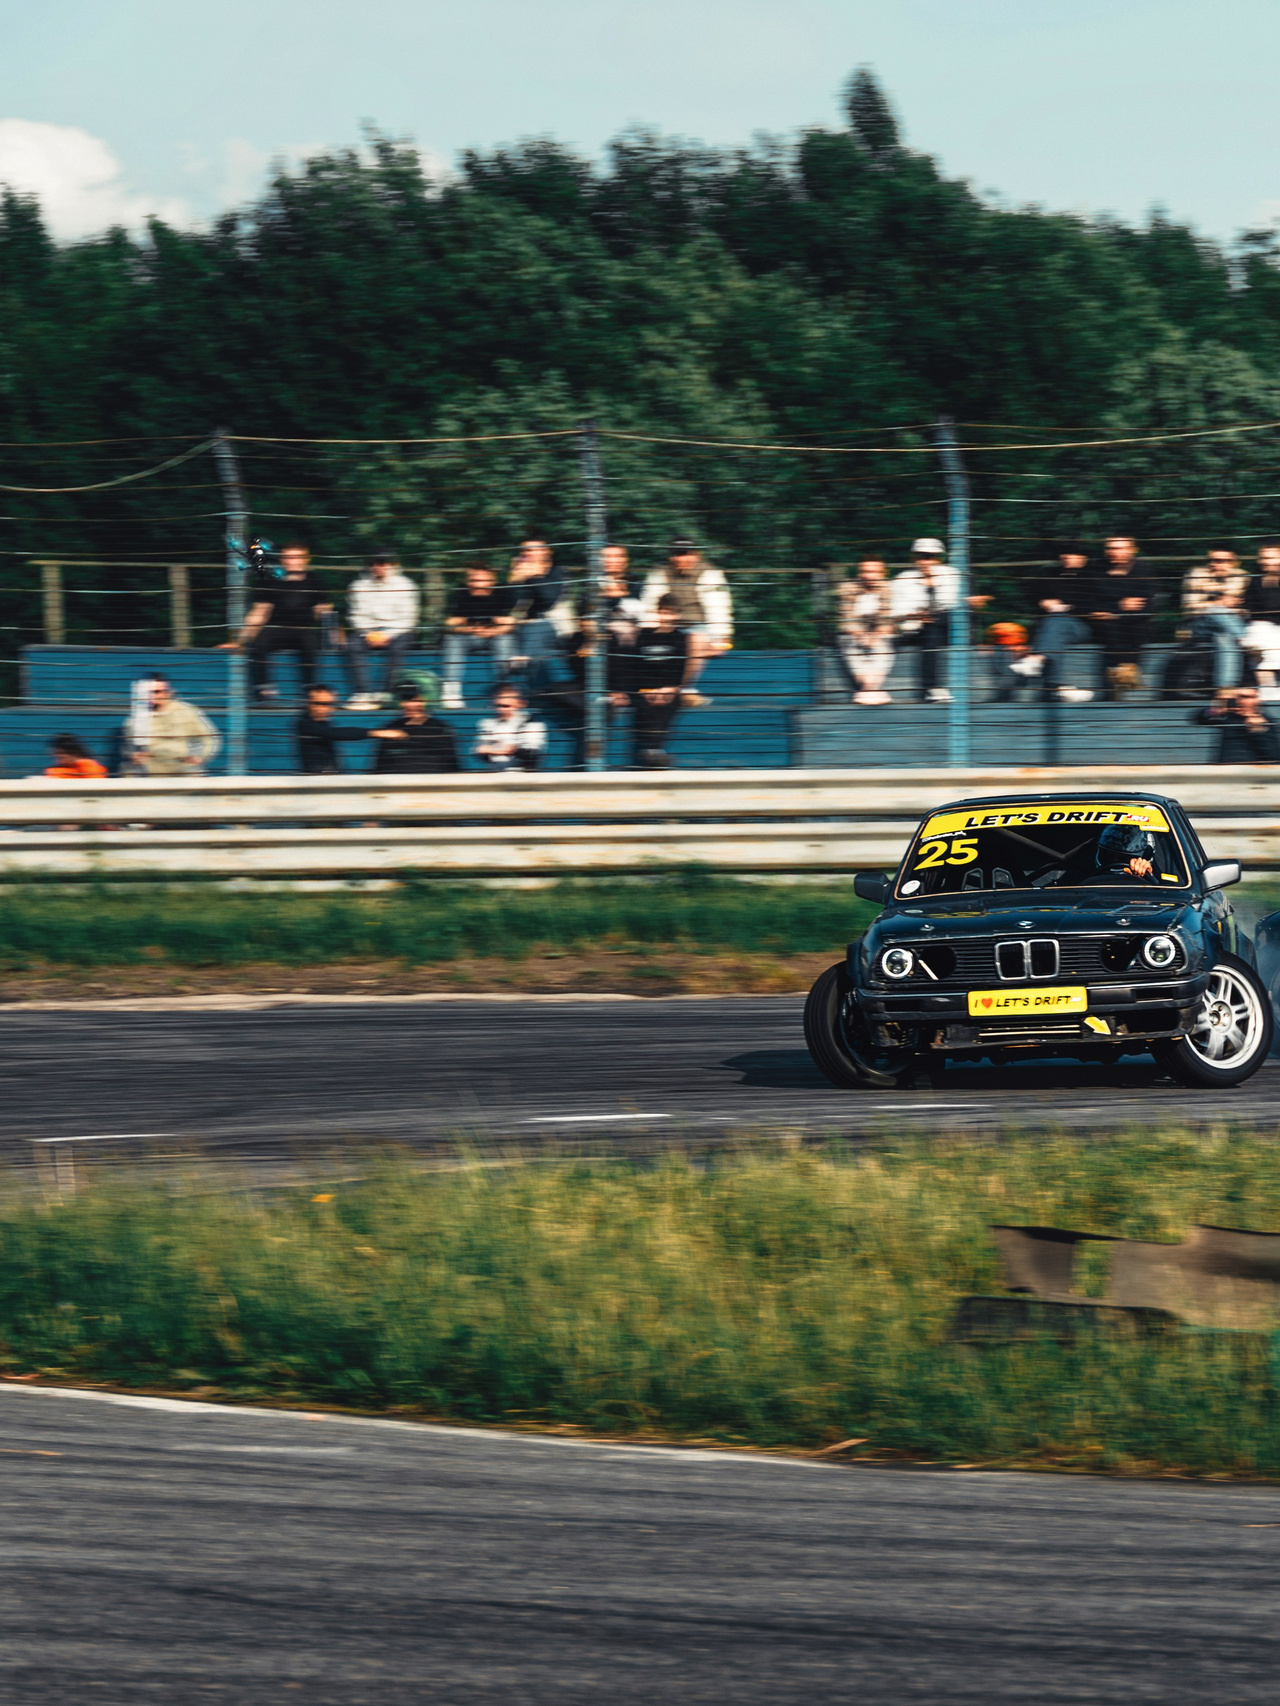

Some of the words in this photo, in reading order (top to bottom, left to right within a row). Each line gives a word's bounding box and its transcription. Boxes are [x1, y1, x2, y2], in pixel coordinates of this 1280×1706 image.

[964, 812, 1040, 828] LET'S
[913, 838, 979, 871] 25
[974, 999, 979, 1008] I
[995, 997, 1030, 1008] LET'S
